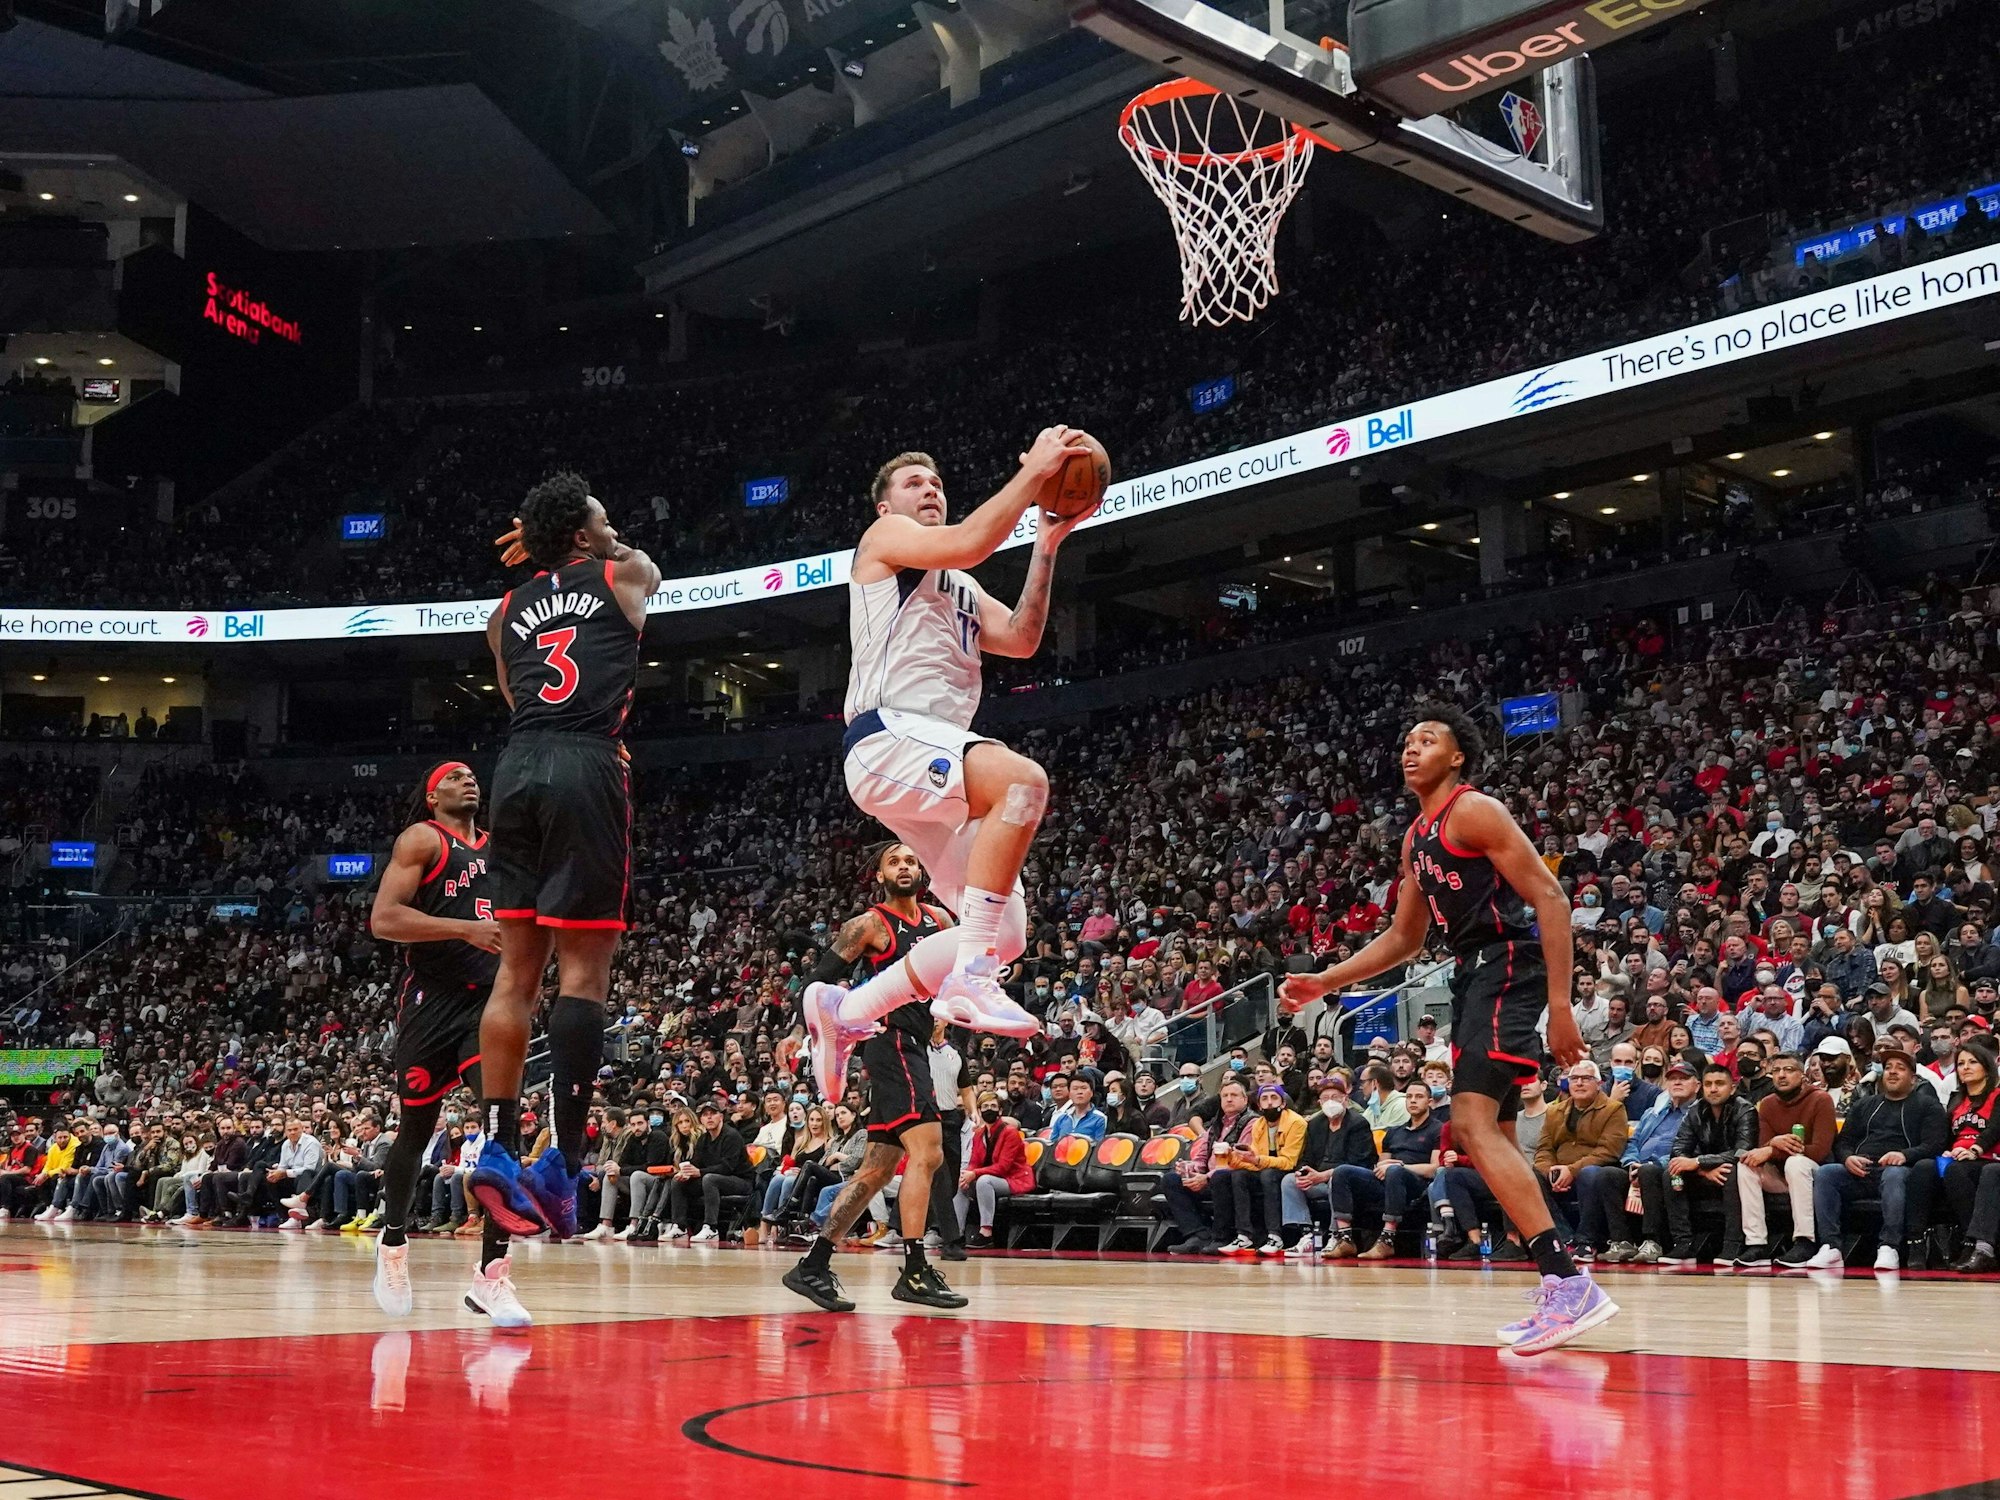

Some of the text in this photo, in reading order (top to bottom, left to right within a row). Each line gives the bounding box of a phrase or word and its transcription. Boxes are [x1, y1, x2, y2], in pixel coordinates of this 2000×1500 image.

[1417, 21, 1585, 91] Uber
[1918, 204, 1958, 230] IBM
[206, 271, 302, 344] Scotiabank
[1715, 328, 1751, 354] no
[1761, 302, 1846, 349] place
[1856, 284, 1921, 317] like
[202, 297, 260, 345] Arena
[581, 366, 626, 386] 306
[1198, 384, 1226, 406] IBM
[1368, 409, 1413, 449] Bell
[1131, 482, 1165, 508] like
[1172, 467, 1232, 496] home
[1239, 445, 1302, 480] court.
[752, 484, 779, 501] IBM
[26, 497, 77, 520] 305
[349, 520, 379, 534] IBM
[796, 558, 832, 587] Bell
[31, 614, 93, 634] home
[99, 619, 162, 635] court.
[224, 614, 264, 638] Bell
[510, 592, 604, 641] ANUNOBY
[1337, 636, 1365, 657] 107
[536, 626, 579, 704] 3
[352, 764, 377, 777] 105
[58, 848, 89, 861] IBM
[335, 861, 365, 875] IBM
[474, 897, 493, 921] 5
